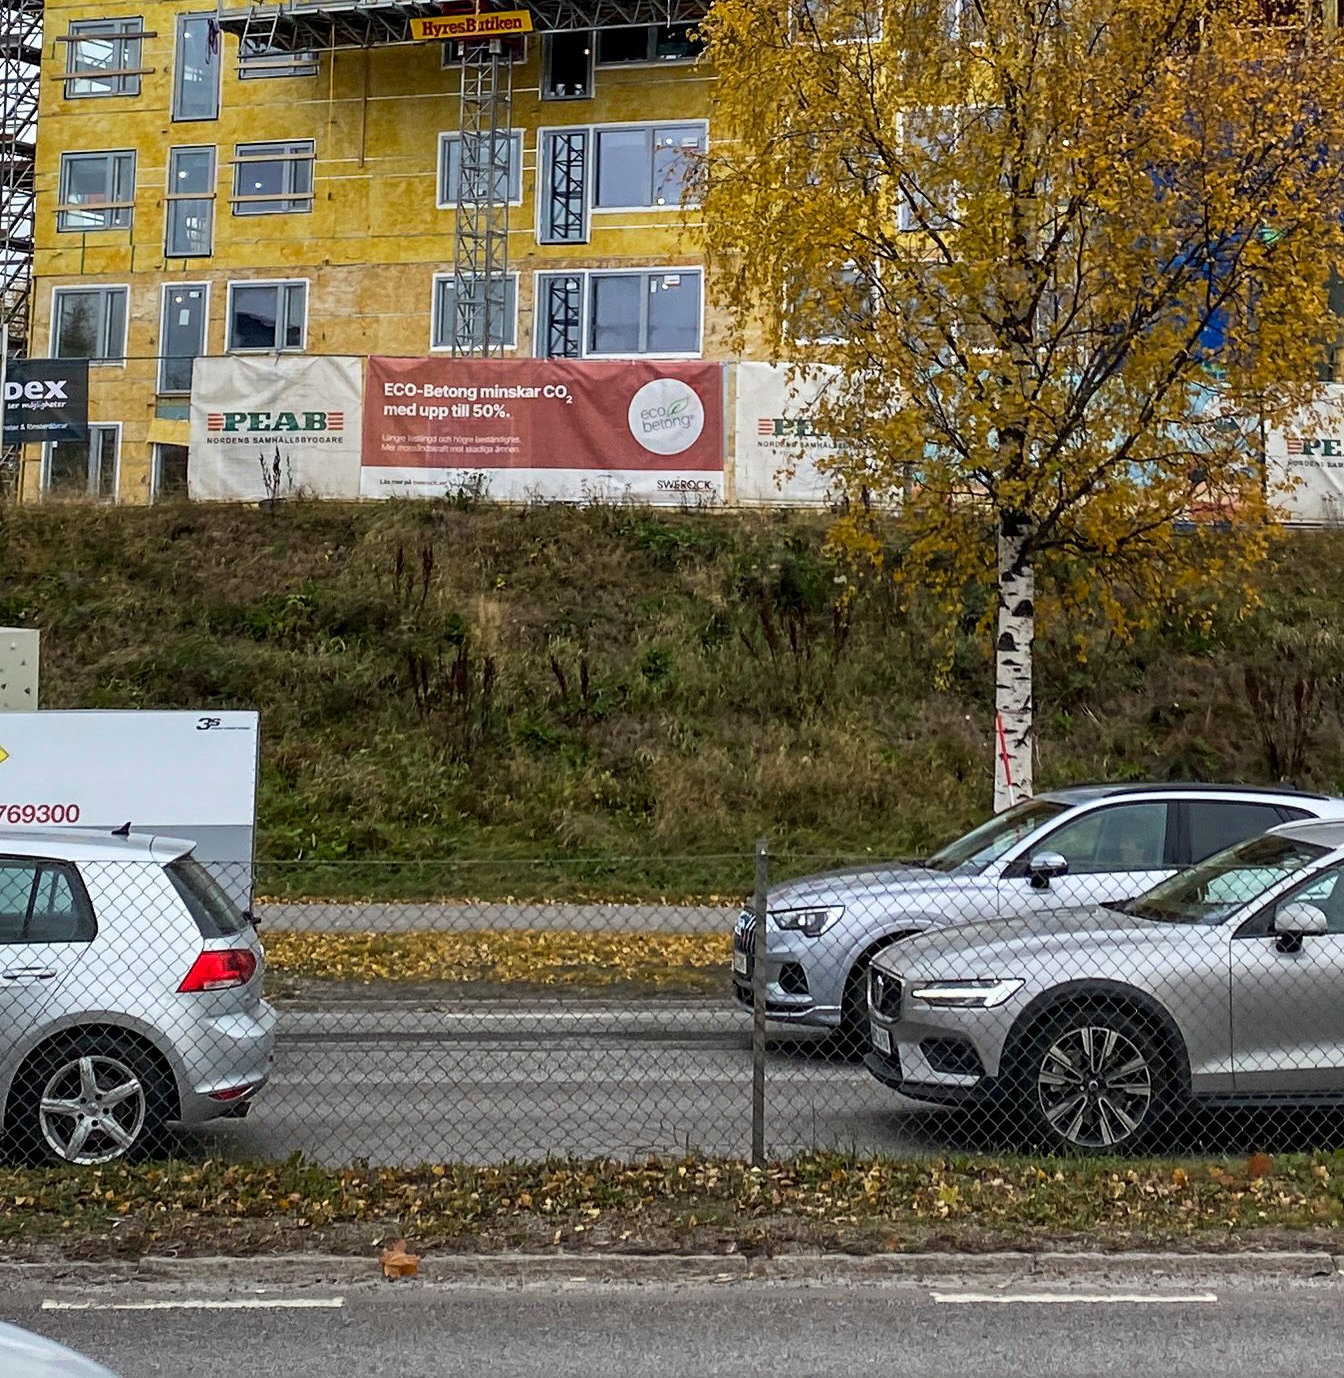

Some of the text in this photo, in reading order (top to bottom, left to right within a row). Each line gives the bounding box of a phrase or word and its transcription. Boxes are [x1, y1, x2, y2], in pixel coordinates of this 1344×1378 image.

[383, 382, 477, 401] ECO-Betong
[480, 383, 542, 398] minskar
[383, 403, 511, 420] med upp till 50%.
[640, 406, 666, 420] eco
[222, 411, 328, 432] PEAB
[206, 436, 250, 445] NORDENS
